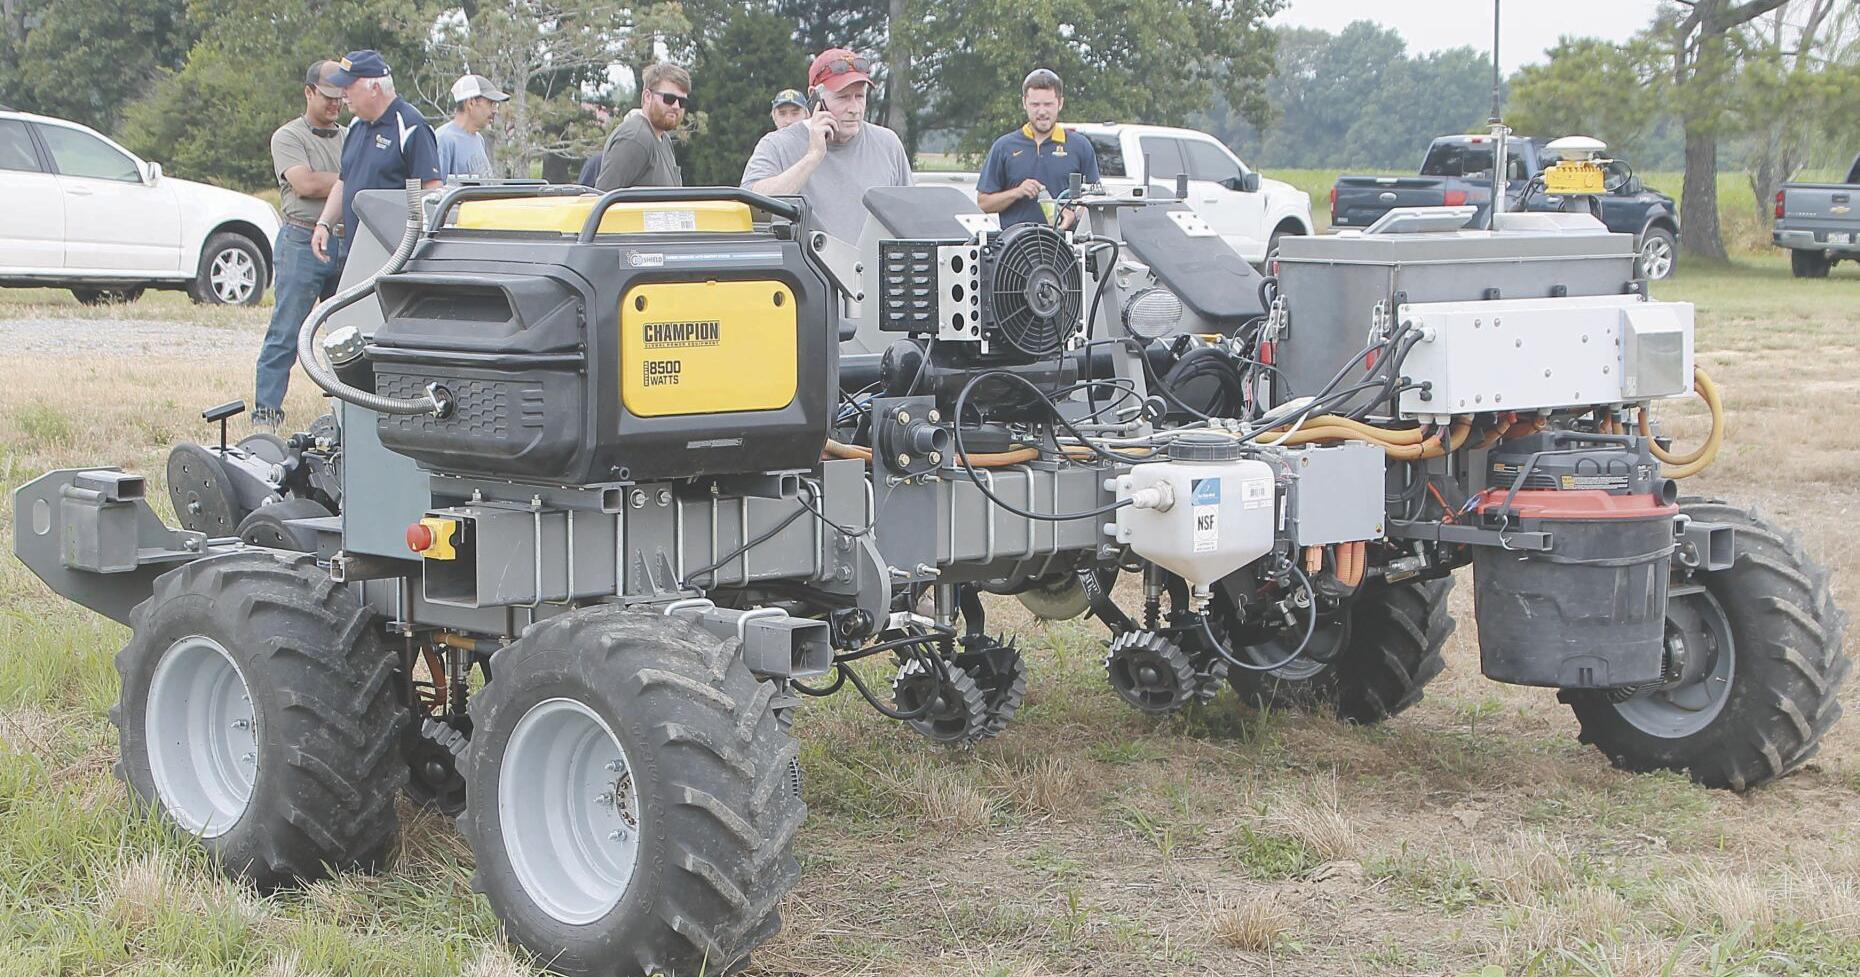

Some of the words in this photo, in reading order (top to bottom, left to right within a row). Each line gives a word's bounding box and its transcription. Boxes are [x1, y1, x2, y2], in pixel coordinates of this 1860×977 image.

[644, 322, 719, 342] CHAMPION
[650, 360, 681, 374] 8500
[650, 375, 679, 386] WATTS
[1197, 514, 1215, 531] NSF
